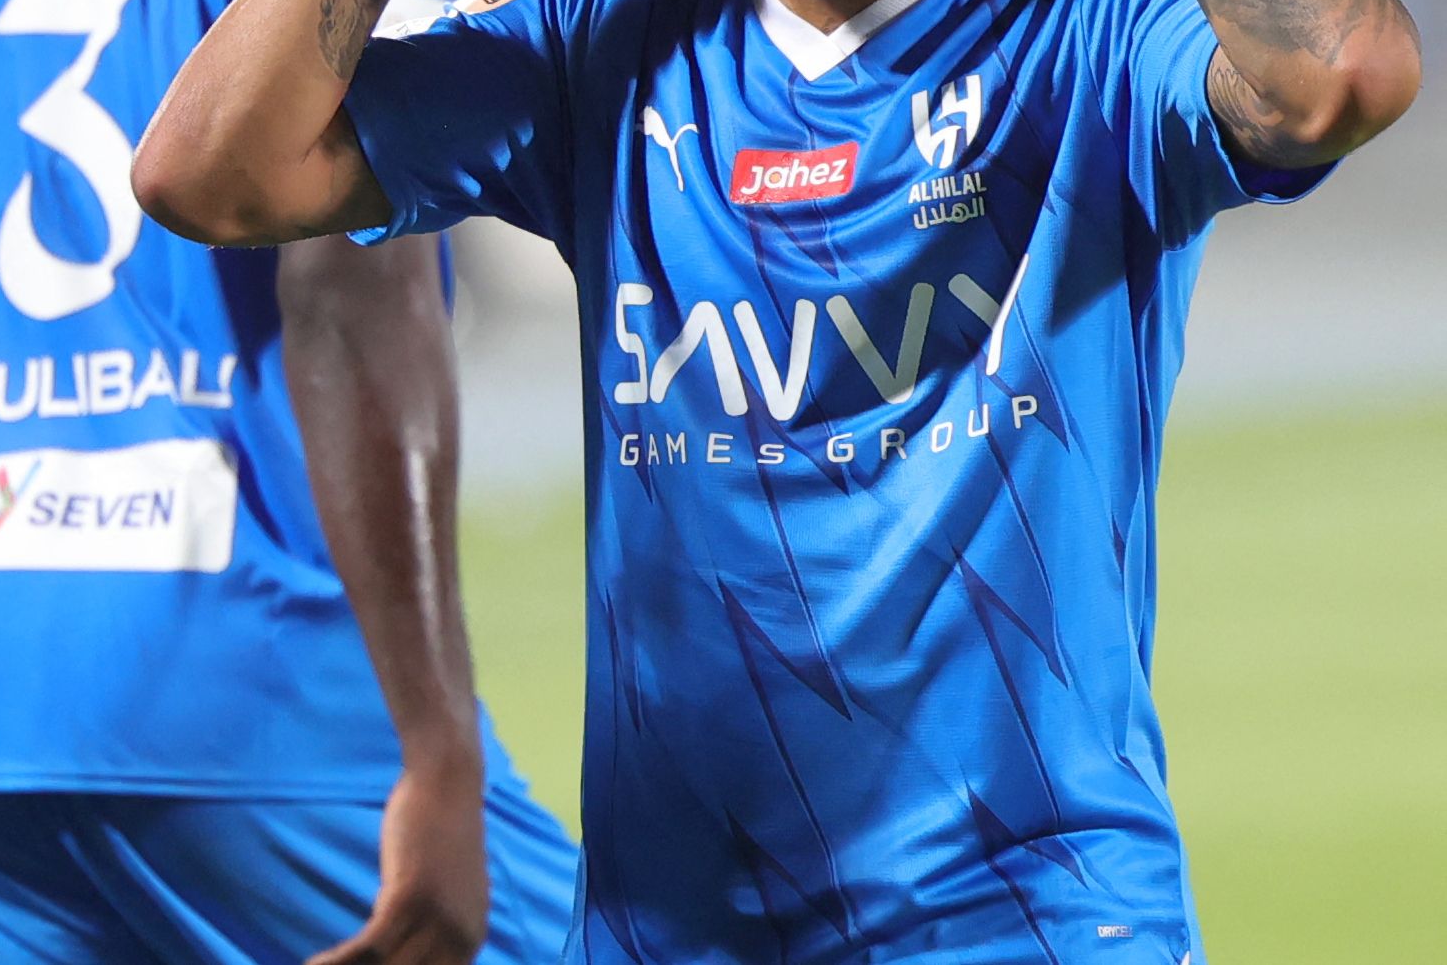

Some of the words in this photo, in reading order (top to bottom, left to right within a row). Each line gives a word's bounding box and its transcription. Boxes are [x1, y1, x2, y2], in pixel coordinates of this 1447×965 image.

[740, 157, 848, 196] jahez
[907, 171, 988, 205] ALHILAL
[913, 197, 986, 231] الهلال
[612, 252, 1030, 422] SAVVY
[619, 431, 786, 467] GAMES
[825, 393, 1039, 465] GROUP
[28, 487, 176, 530] SEVEN
